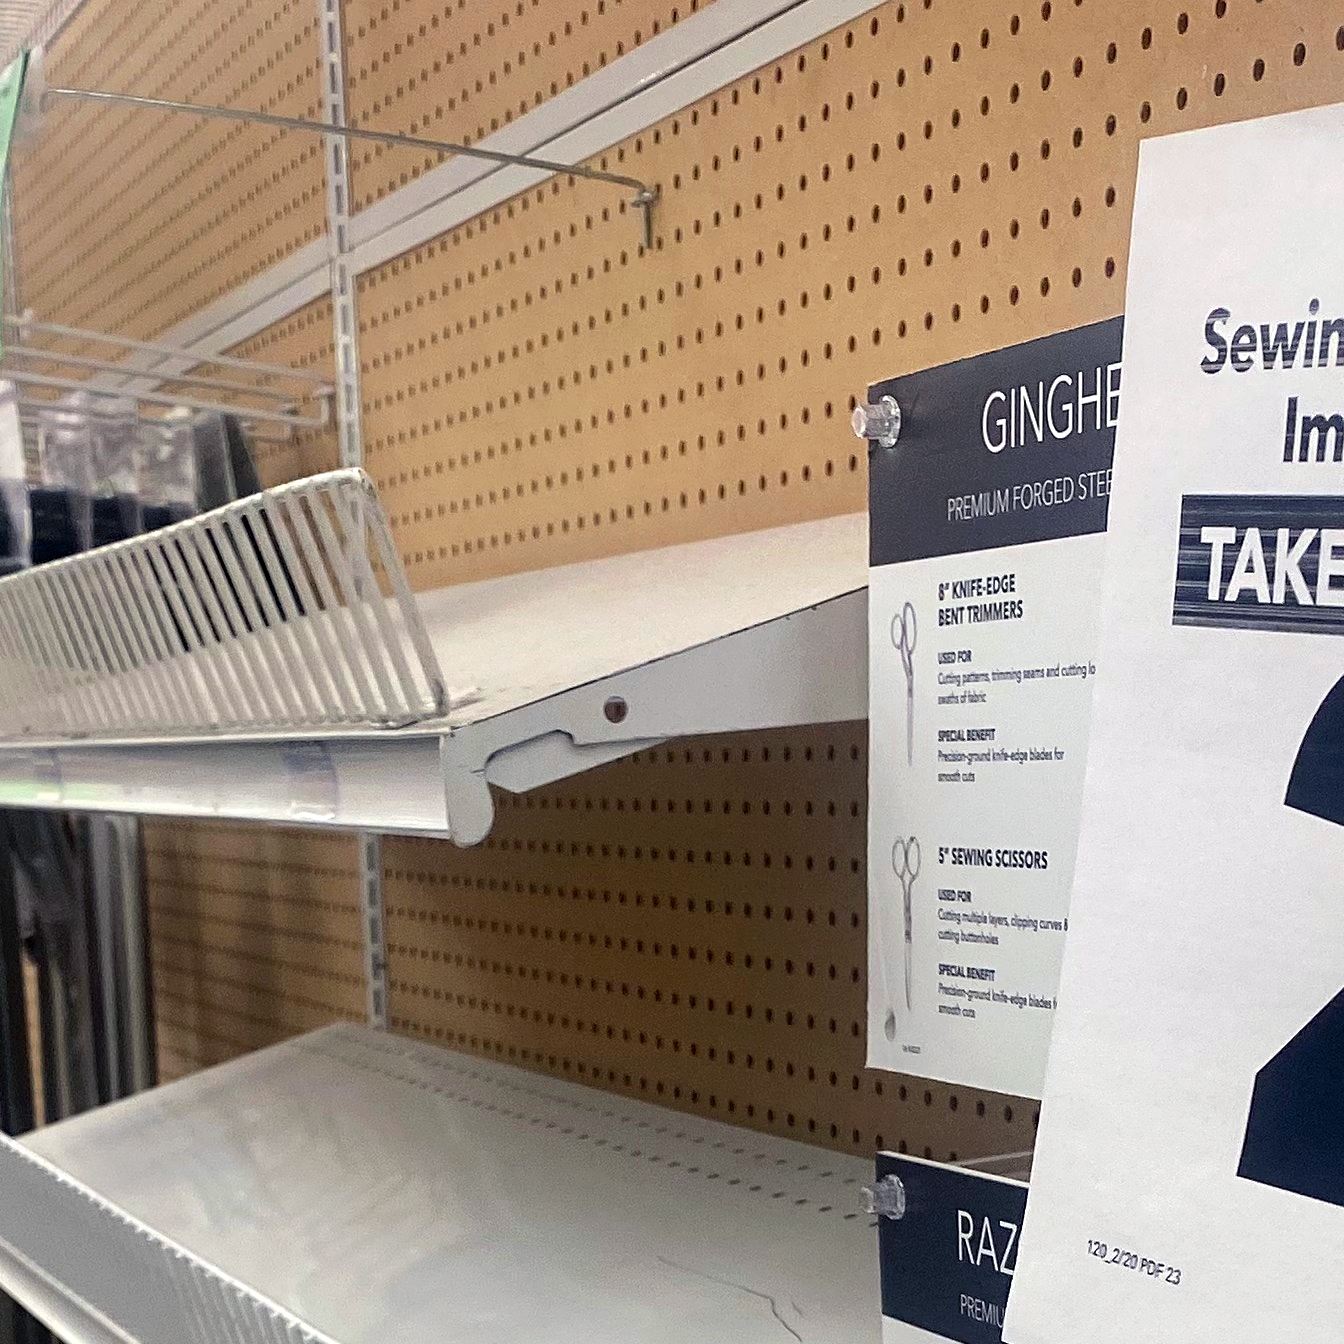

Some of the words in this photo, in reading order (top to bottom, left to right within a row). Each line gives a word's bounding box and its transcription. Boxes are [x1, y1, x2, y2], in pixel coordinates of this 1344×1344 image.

[948, 489, 1009, 520] PREMIUM
[1013, 477, 1074, 509] FORGED
[952, 574, 1015, 599] KNIFE-EDGE
[939, 607, 964, 626] BENT
[967, 600, 1023, 623] TRIMMERS
[952, 848, 992, 866] SEWING
[996, 850, 1047, 869] SCISSORS
[1140, 1257, 1165, 1278] PDF
[1165, 1267, 1182, 1285] 23
